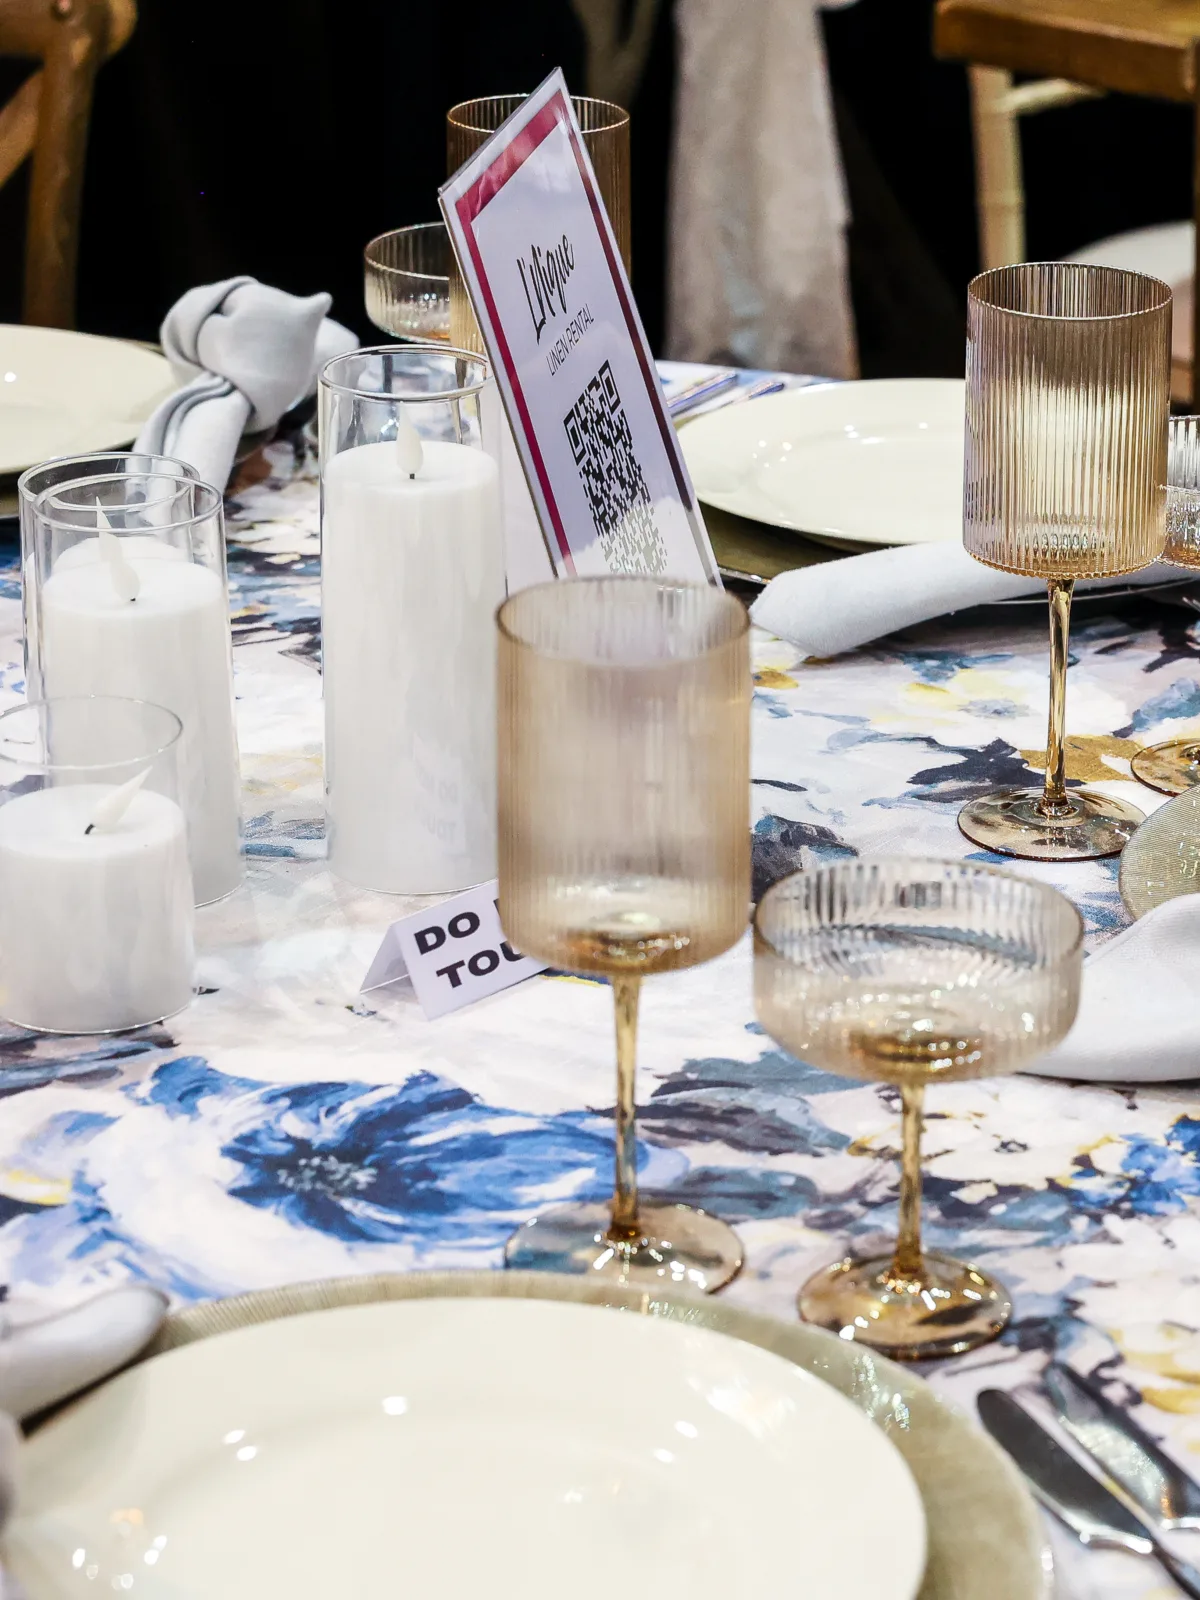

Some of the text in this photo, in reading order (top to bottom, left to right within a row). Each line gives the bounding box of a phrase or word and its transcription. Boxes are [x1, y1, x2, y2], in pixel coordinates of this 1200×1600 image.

[546, 303, 595, 376] LINEN RENTAL
[413, 911, 481, 955] DO
